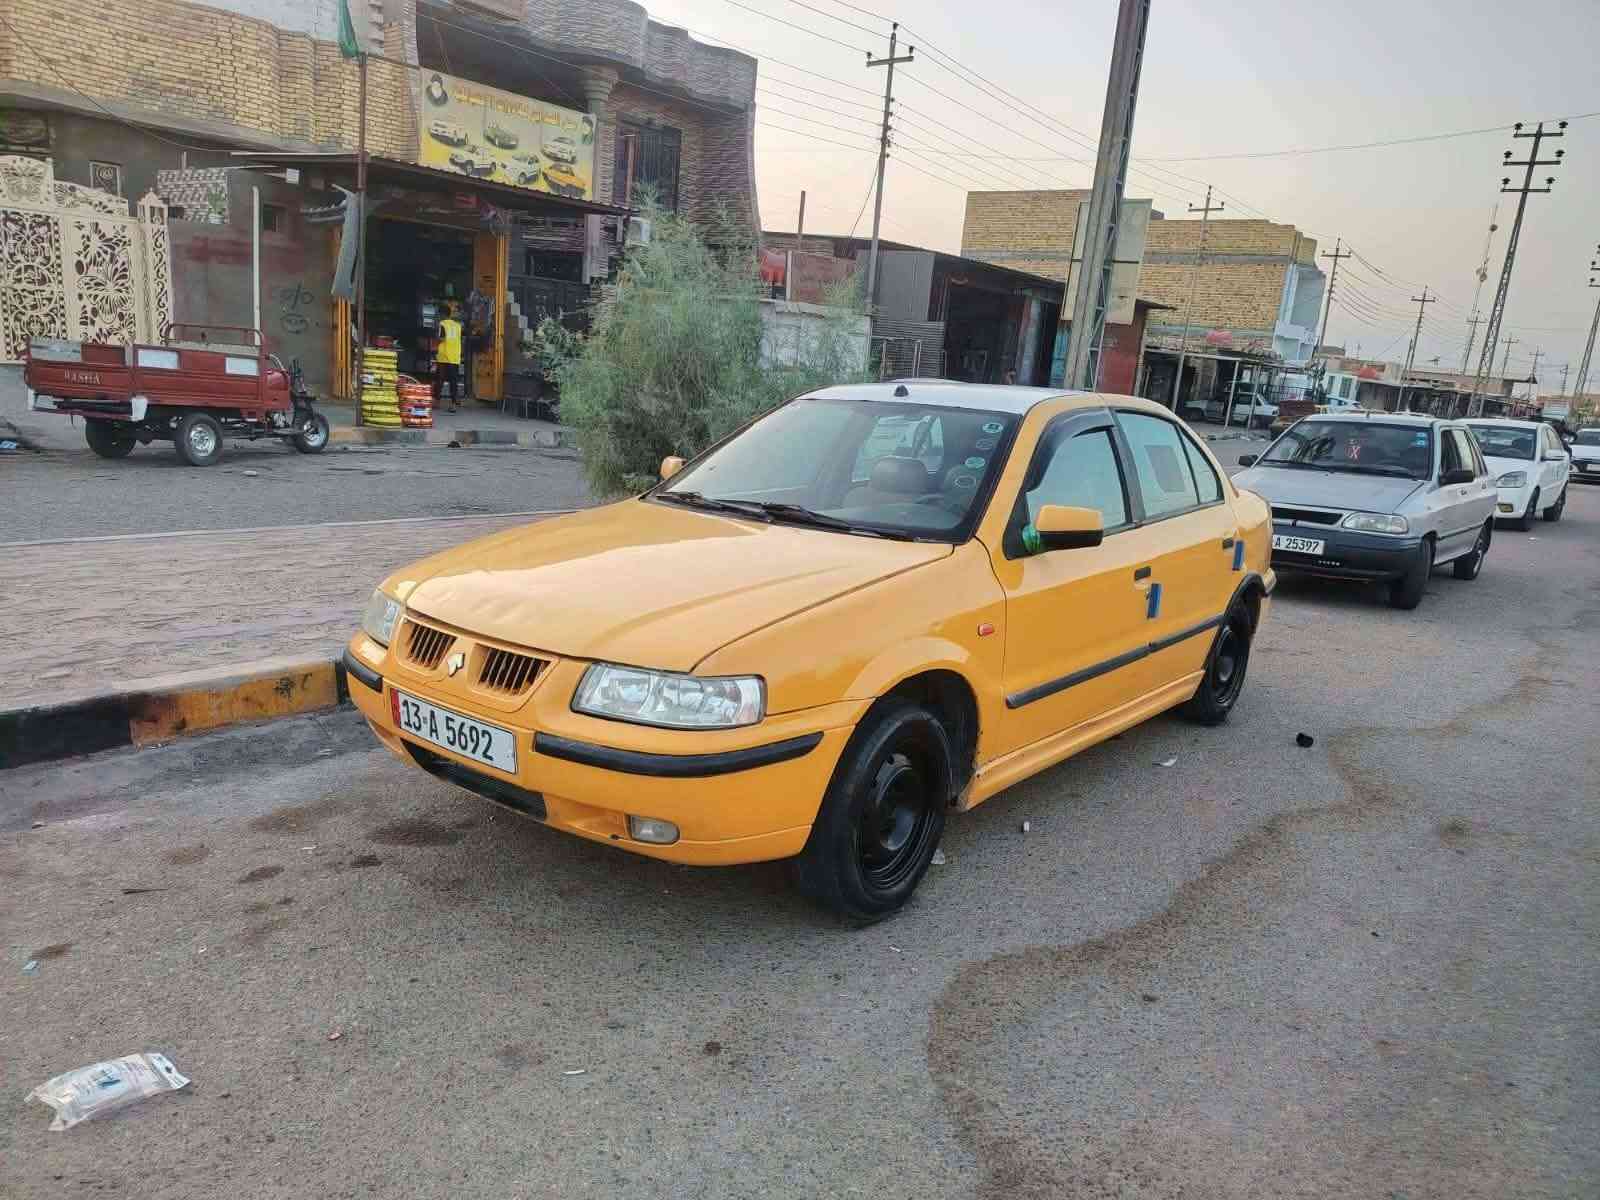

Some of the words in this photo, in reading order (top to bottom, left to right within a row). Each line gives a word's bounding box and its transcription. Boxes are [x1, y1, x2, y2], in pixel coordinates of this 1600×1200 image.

[1285, 537, 1320, 553] 25397
[402, 699, 422, 732] 13
[429, 710, 440, 741] A
[445, 715, 494, 762] 5692
